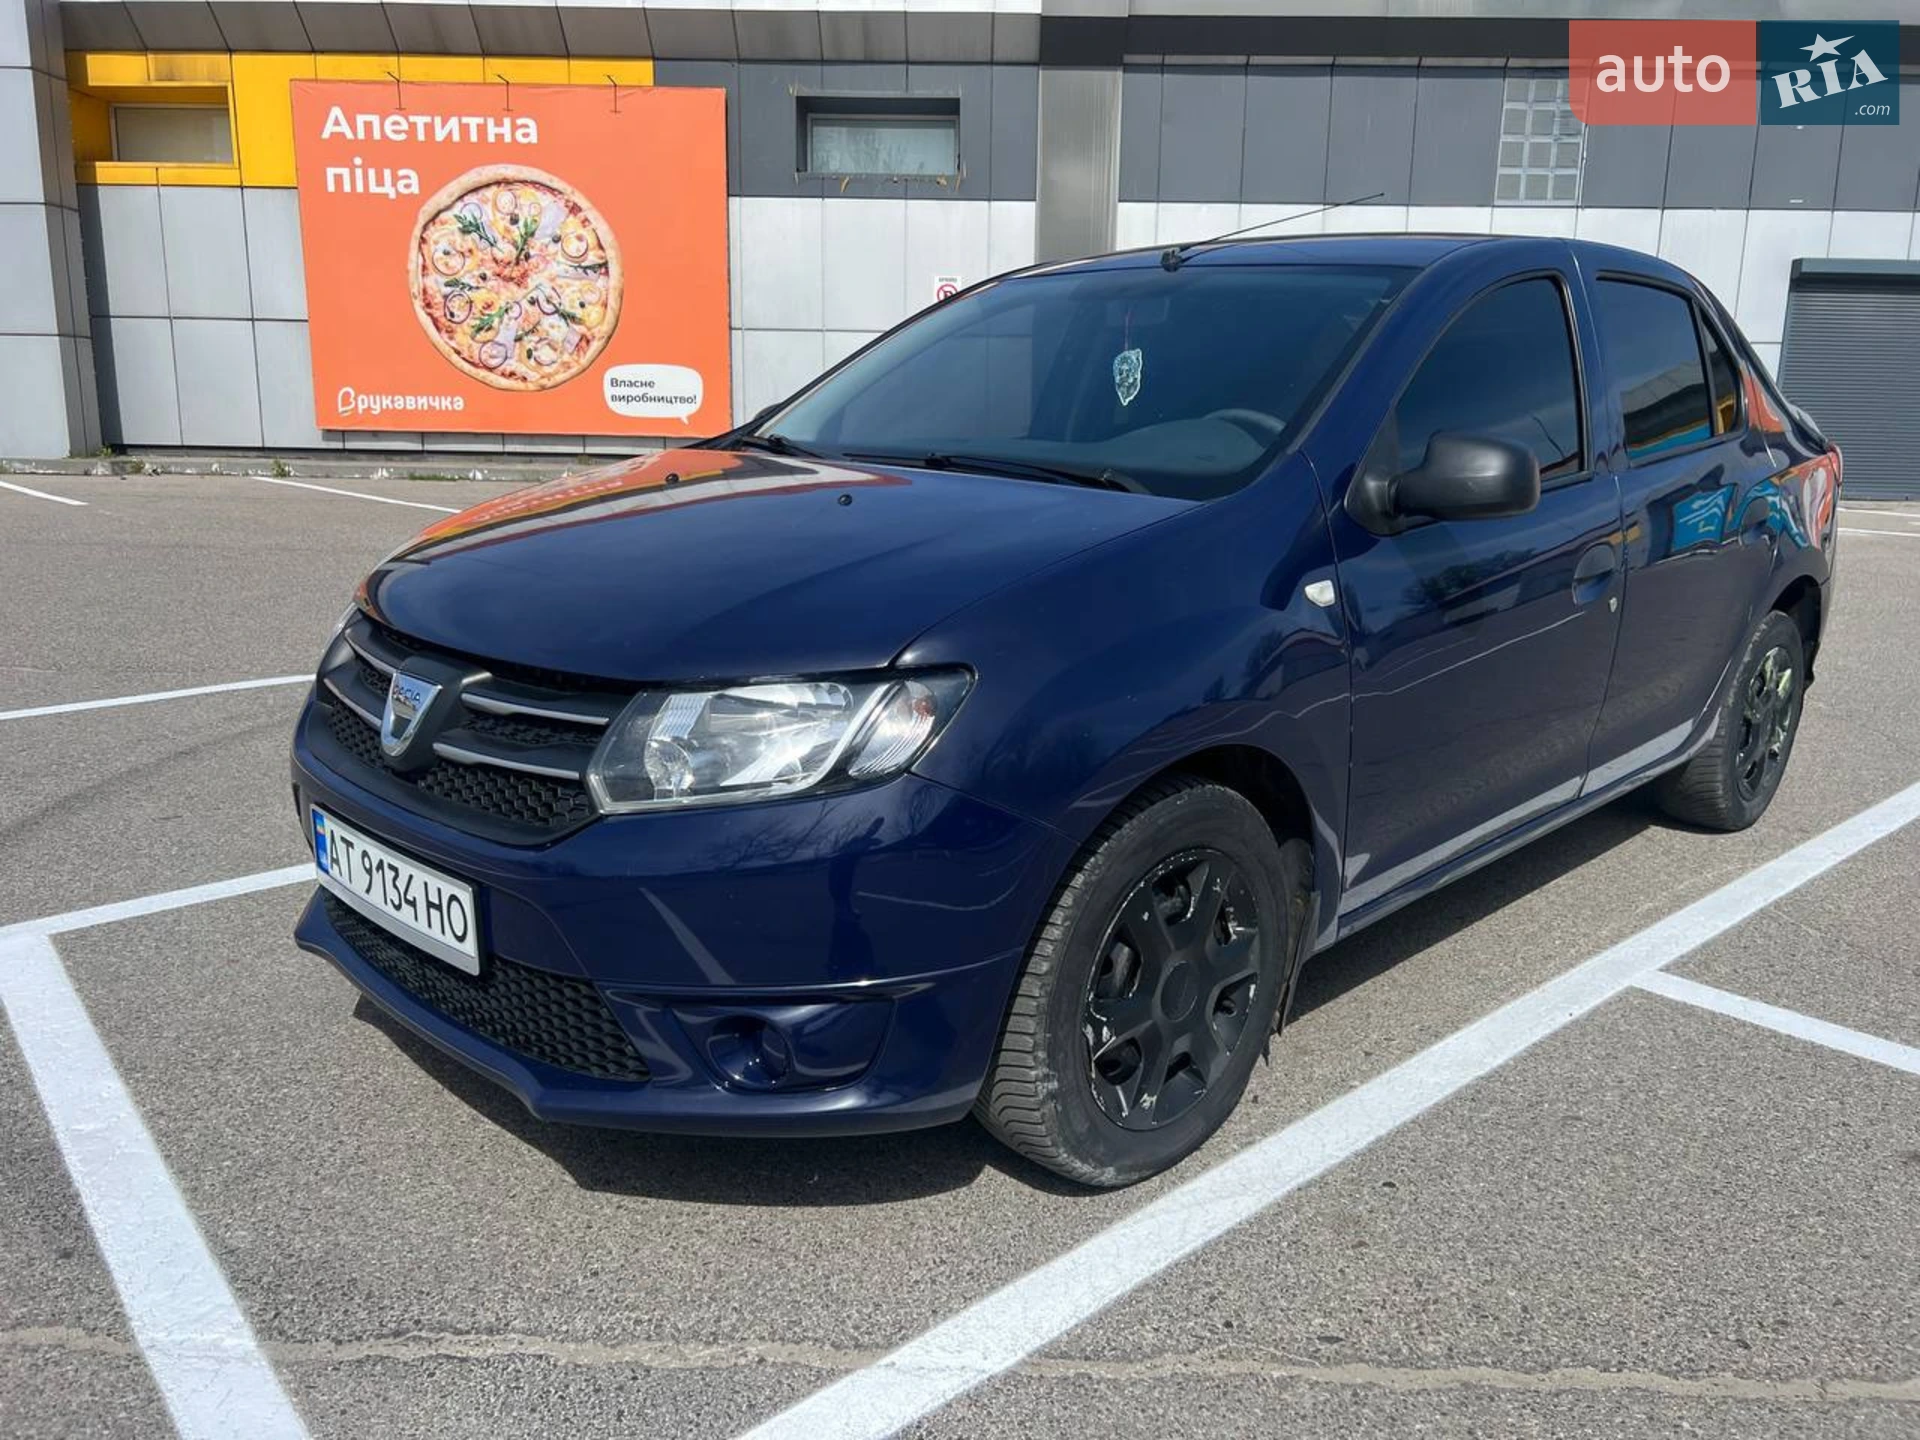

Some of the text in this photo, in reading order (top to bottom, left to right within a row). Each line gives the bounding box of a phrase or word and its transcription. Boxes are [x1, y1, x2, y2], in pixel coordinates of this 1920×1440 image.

[320, 105, 539, 144] Апетитна
[325, 155, 420, 199] піца
[610, 377, 656, 389] Власне
[610, 392, 698, 405] виробництво!
[330, 829, 469, 943] AT 9134 HO
